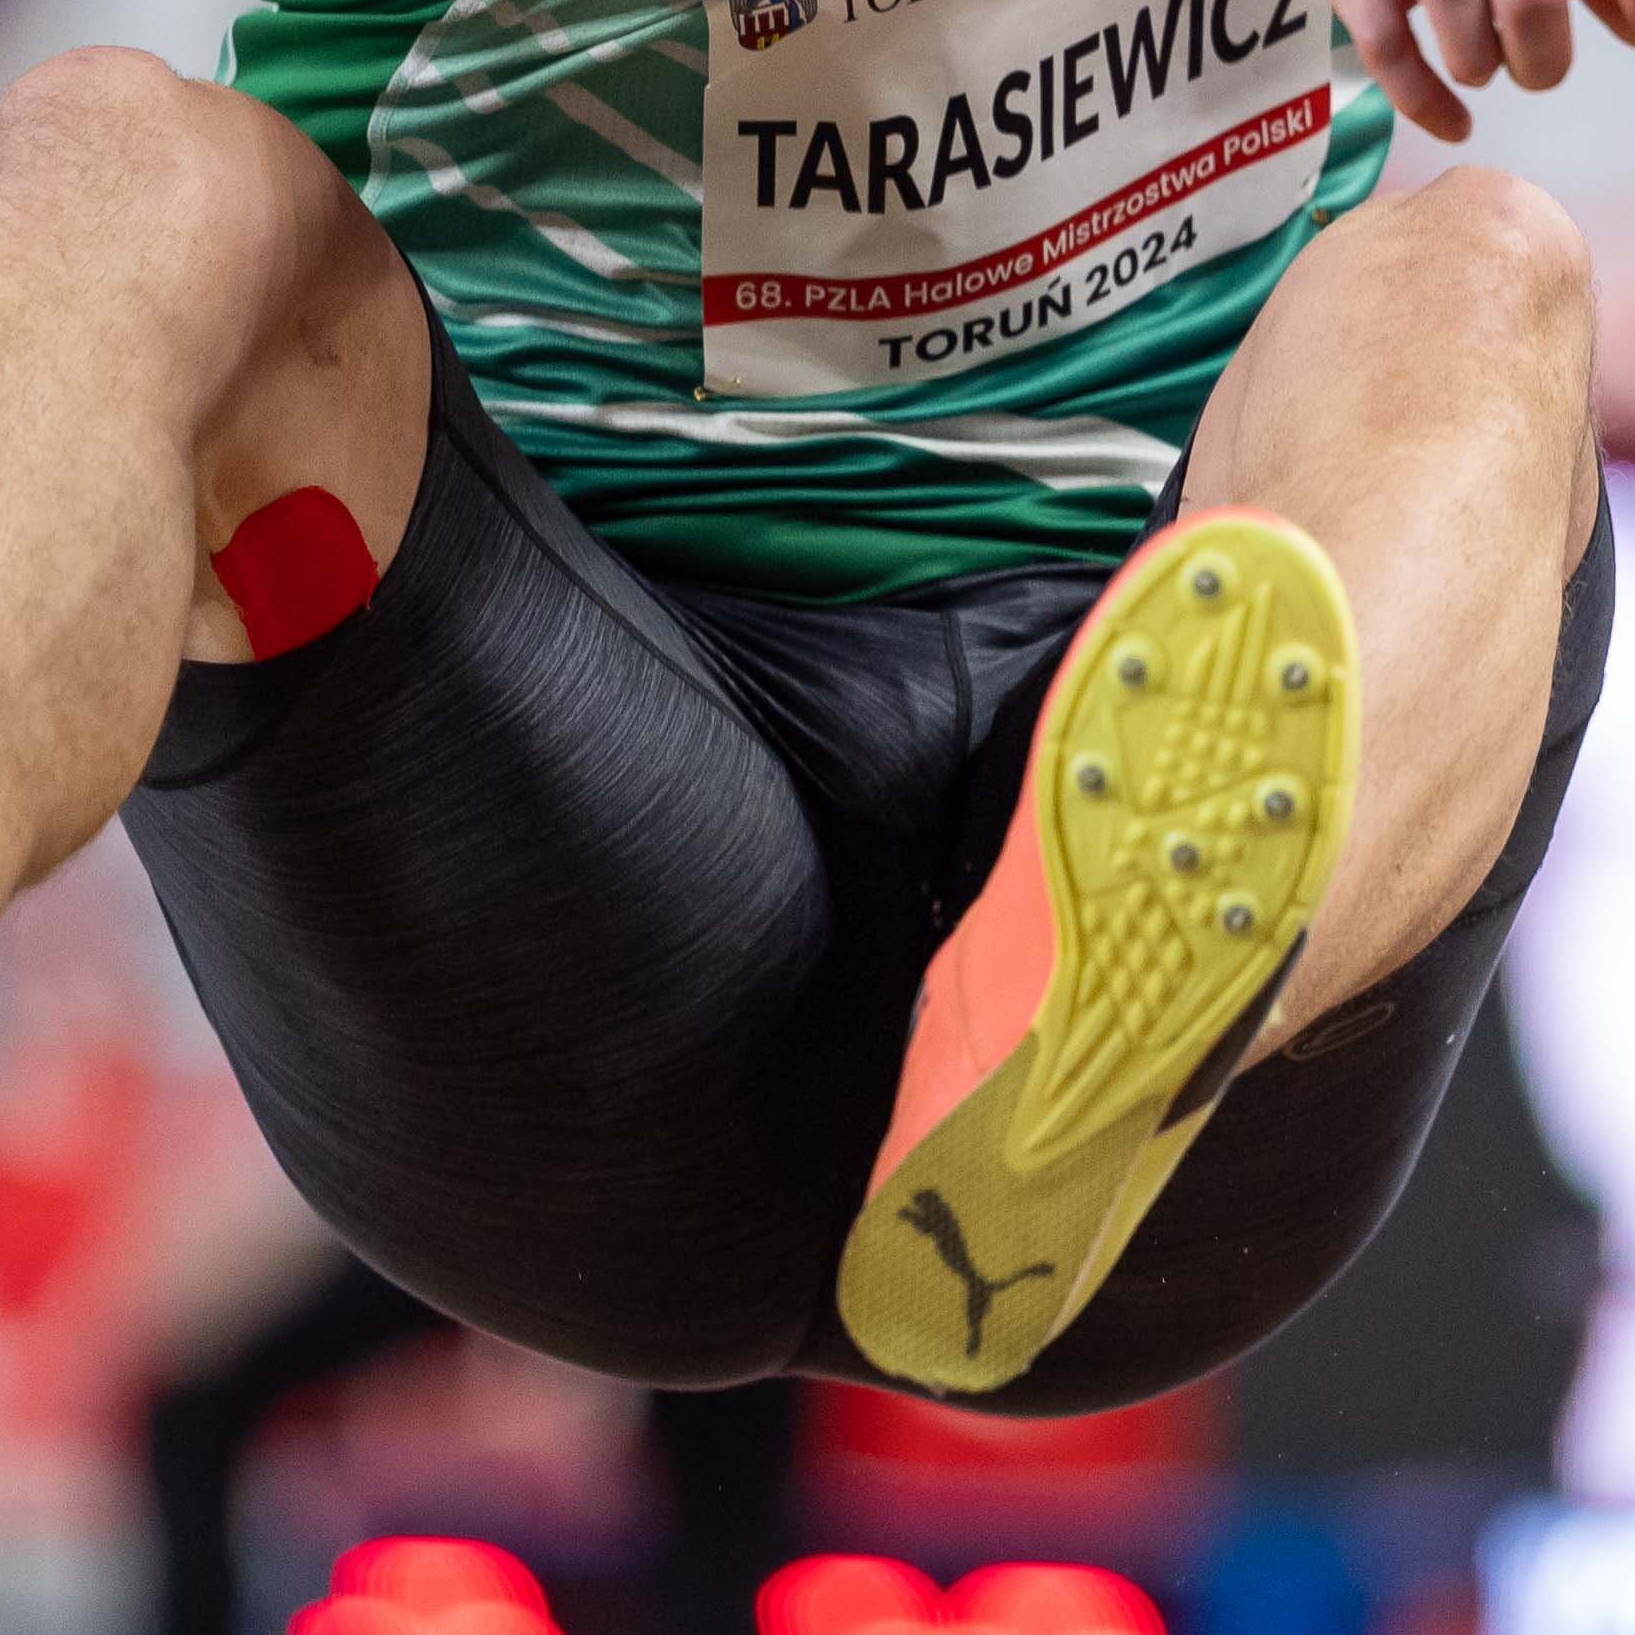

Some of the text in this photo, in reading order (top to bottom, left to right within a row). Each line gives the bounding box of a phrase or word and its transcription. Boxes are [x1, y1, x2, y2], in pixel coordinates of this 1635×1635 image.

[735, 99, 1314, 312] 68. PZLA Halowe Mistrzostwa Polski
[877, 214, 1197, 369] TORUŃ 2024
